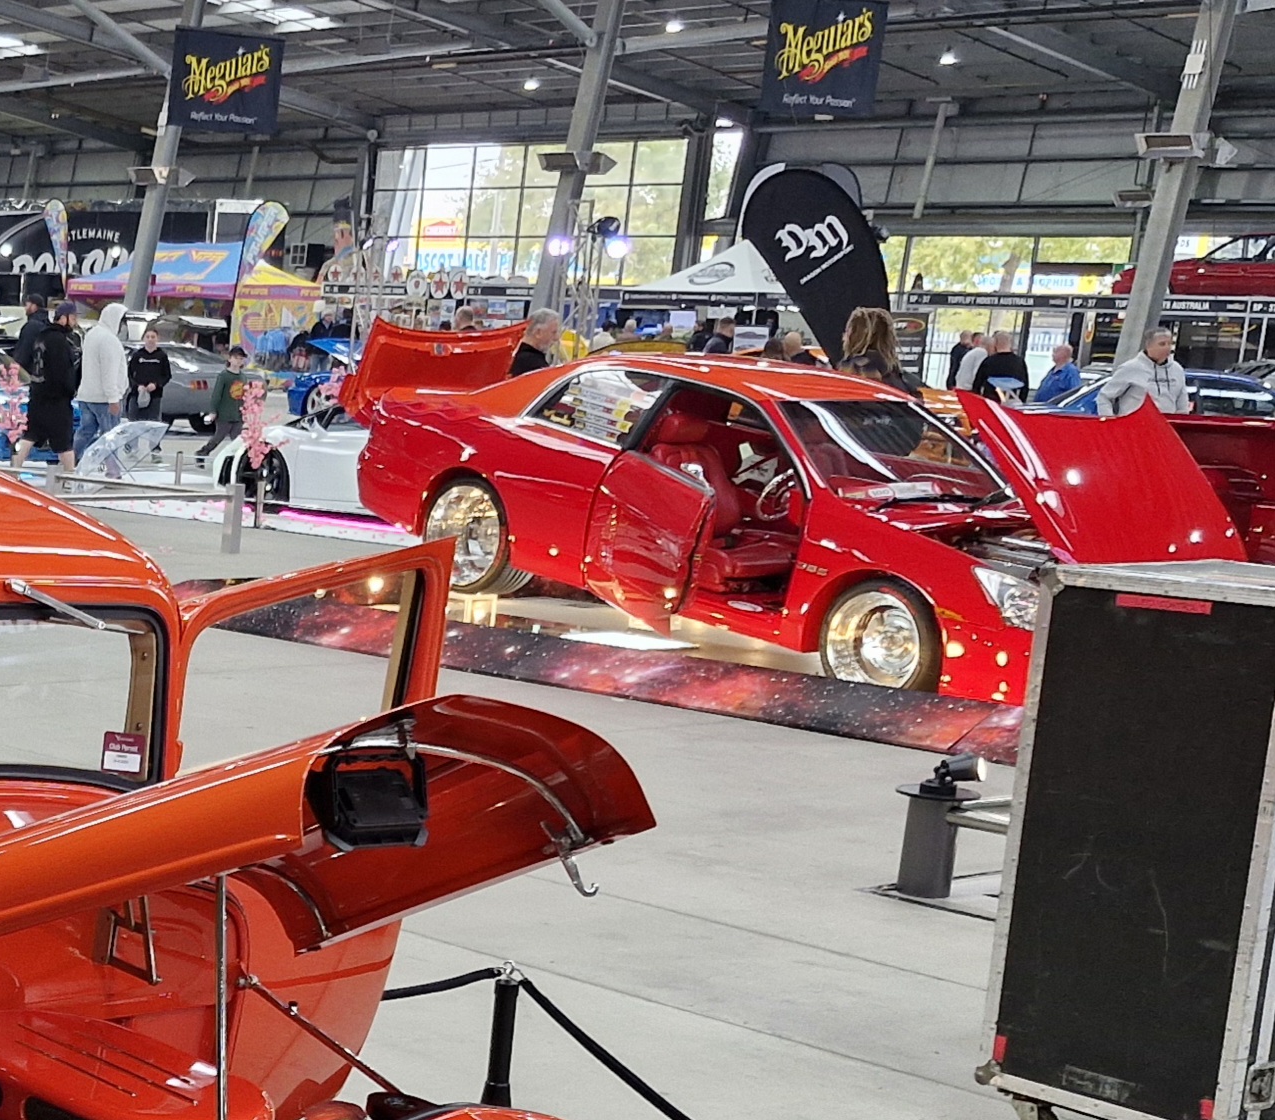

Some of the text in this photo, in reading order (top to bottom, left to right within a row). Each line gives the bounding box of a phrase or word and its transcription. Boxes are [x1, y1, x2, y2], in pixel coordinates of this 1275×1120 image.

[182, 44, 271, 101] Meguiar's
[774, 8, 873, 80] Meguiar's
[1172, 301, 1210, 310] AUSTRALIA
